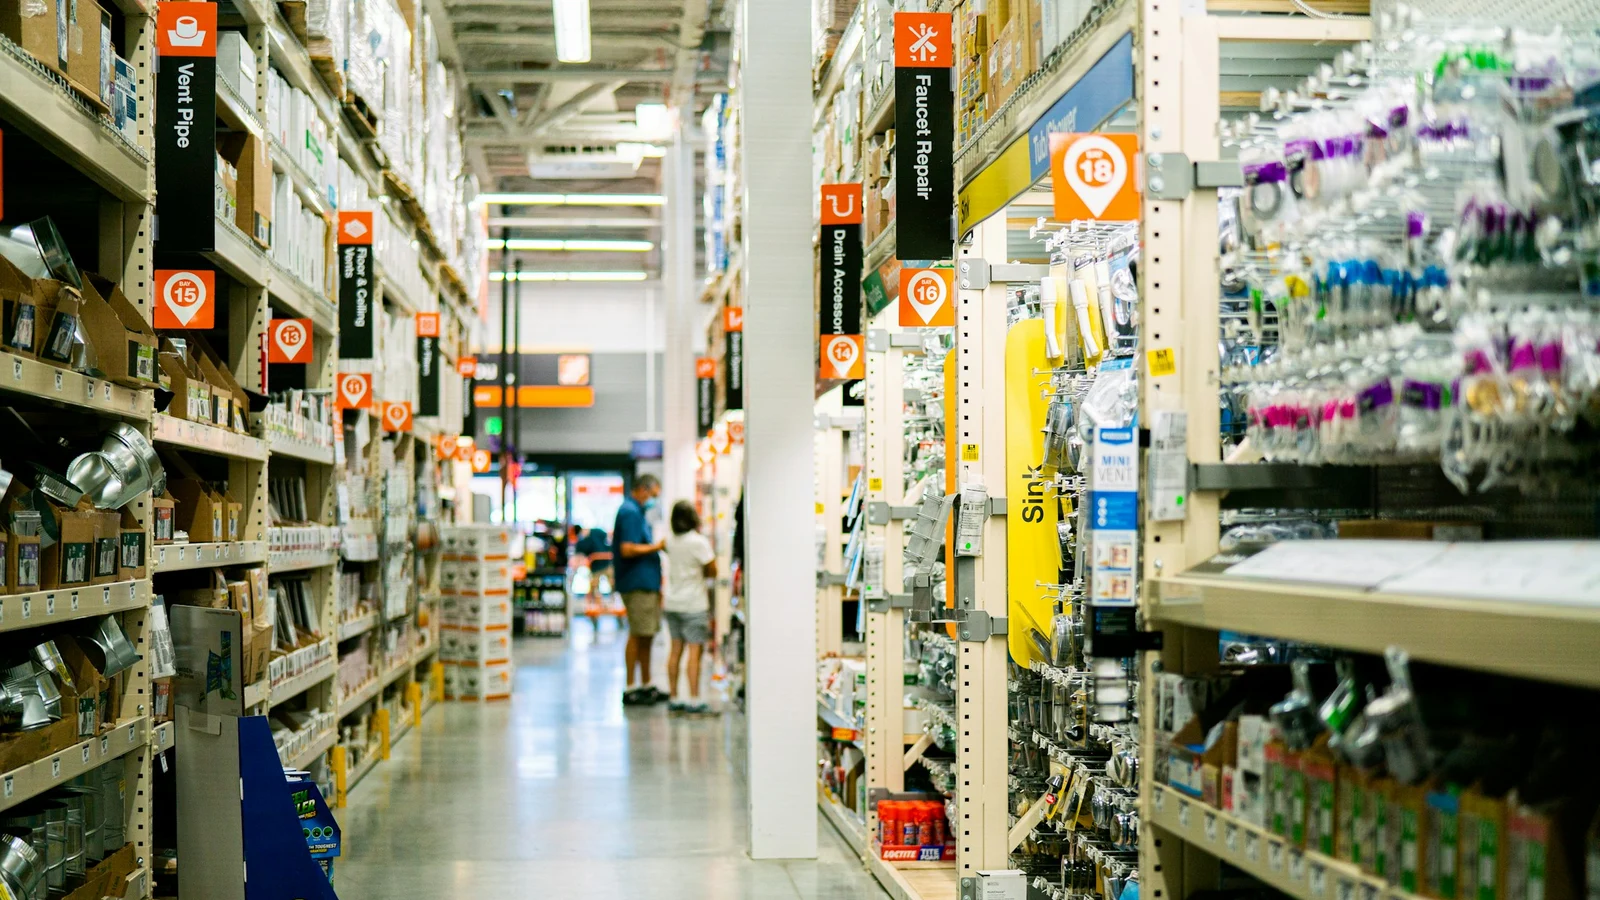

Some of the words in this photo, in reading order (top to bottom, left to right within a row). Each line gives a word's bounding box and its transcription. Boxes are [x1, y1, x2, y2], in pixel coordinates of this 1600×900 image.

[178, 63, 195, 104] Vent
[916, 75, 932, 136] Faucet
[173, 108, 194, 148] Pipe
[913, 140, 932, 200] Repair
[1079, 159, 1114, 183] 18
[833, 229, 846, 266] Drain
[344, 246, 355, 279] Vents
[356, 247, 368, 276] Floor
[356, 277, 368, 288] &
[174, 287, 197, 303] 15
[916, 285, 938, 301] 16
[354, 288, 368, 328] Ceiling
[282, 332, 300, 344] 13
[834, 347, 851, 360] 14
[348, 382, 361, 394] 11
[1102, 456, 1131, 466] MINI
[1098, 468, 1133, 482] VENT
[1022, 464, 1044, 523] Sink
[883, 850, 917, 859] LOCTITE
[921, 848, 940, 856] TITE
